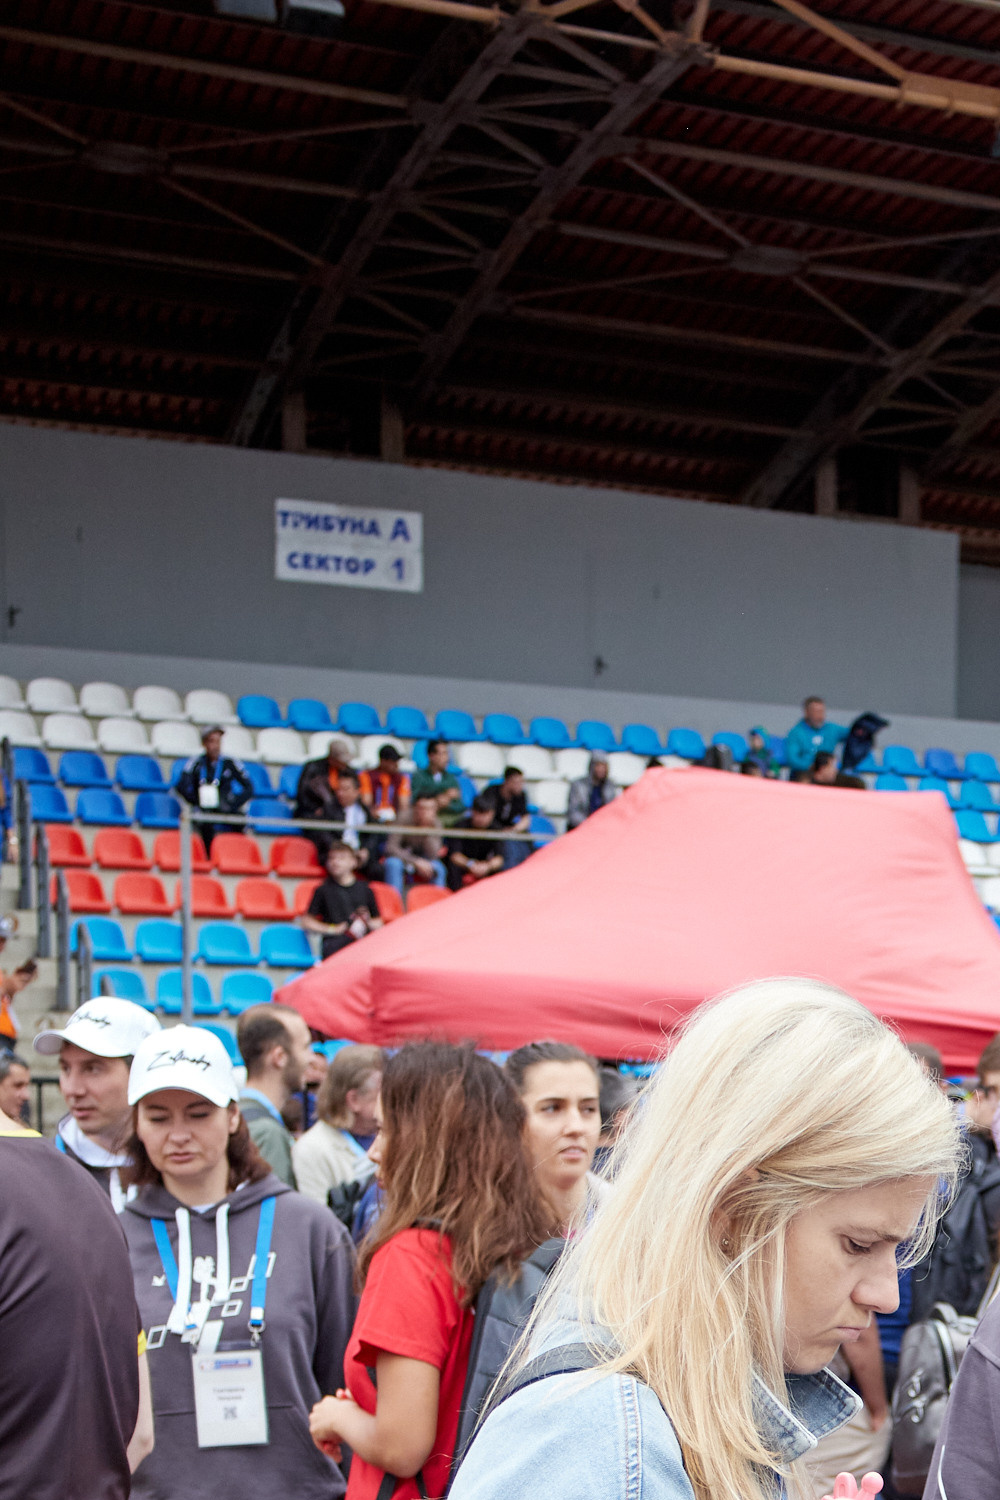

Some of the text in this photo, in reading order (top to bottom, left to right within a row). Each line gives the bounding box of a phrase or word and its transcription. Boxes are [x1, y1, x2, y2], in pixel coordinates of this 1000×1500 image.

[278, 510, 381, 537] ТРИБУНА
[286, 552, 404, 580] СЕКТОР 1
